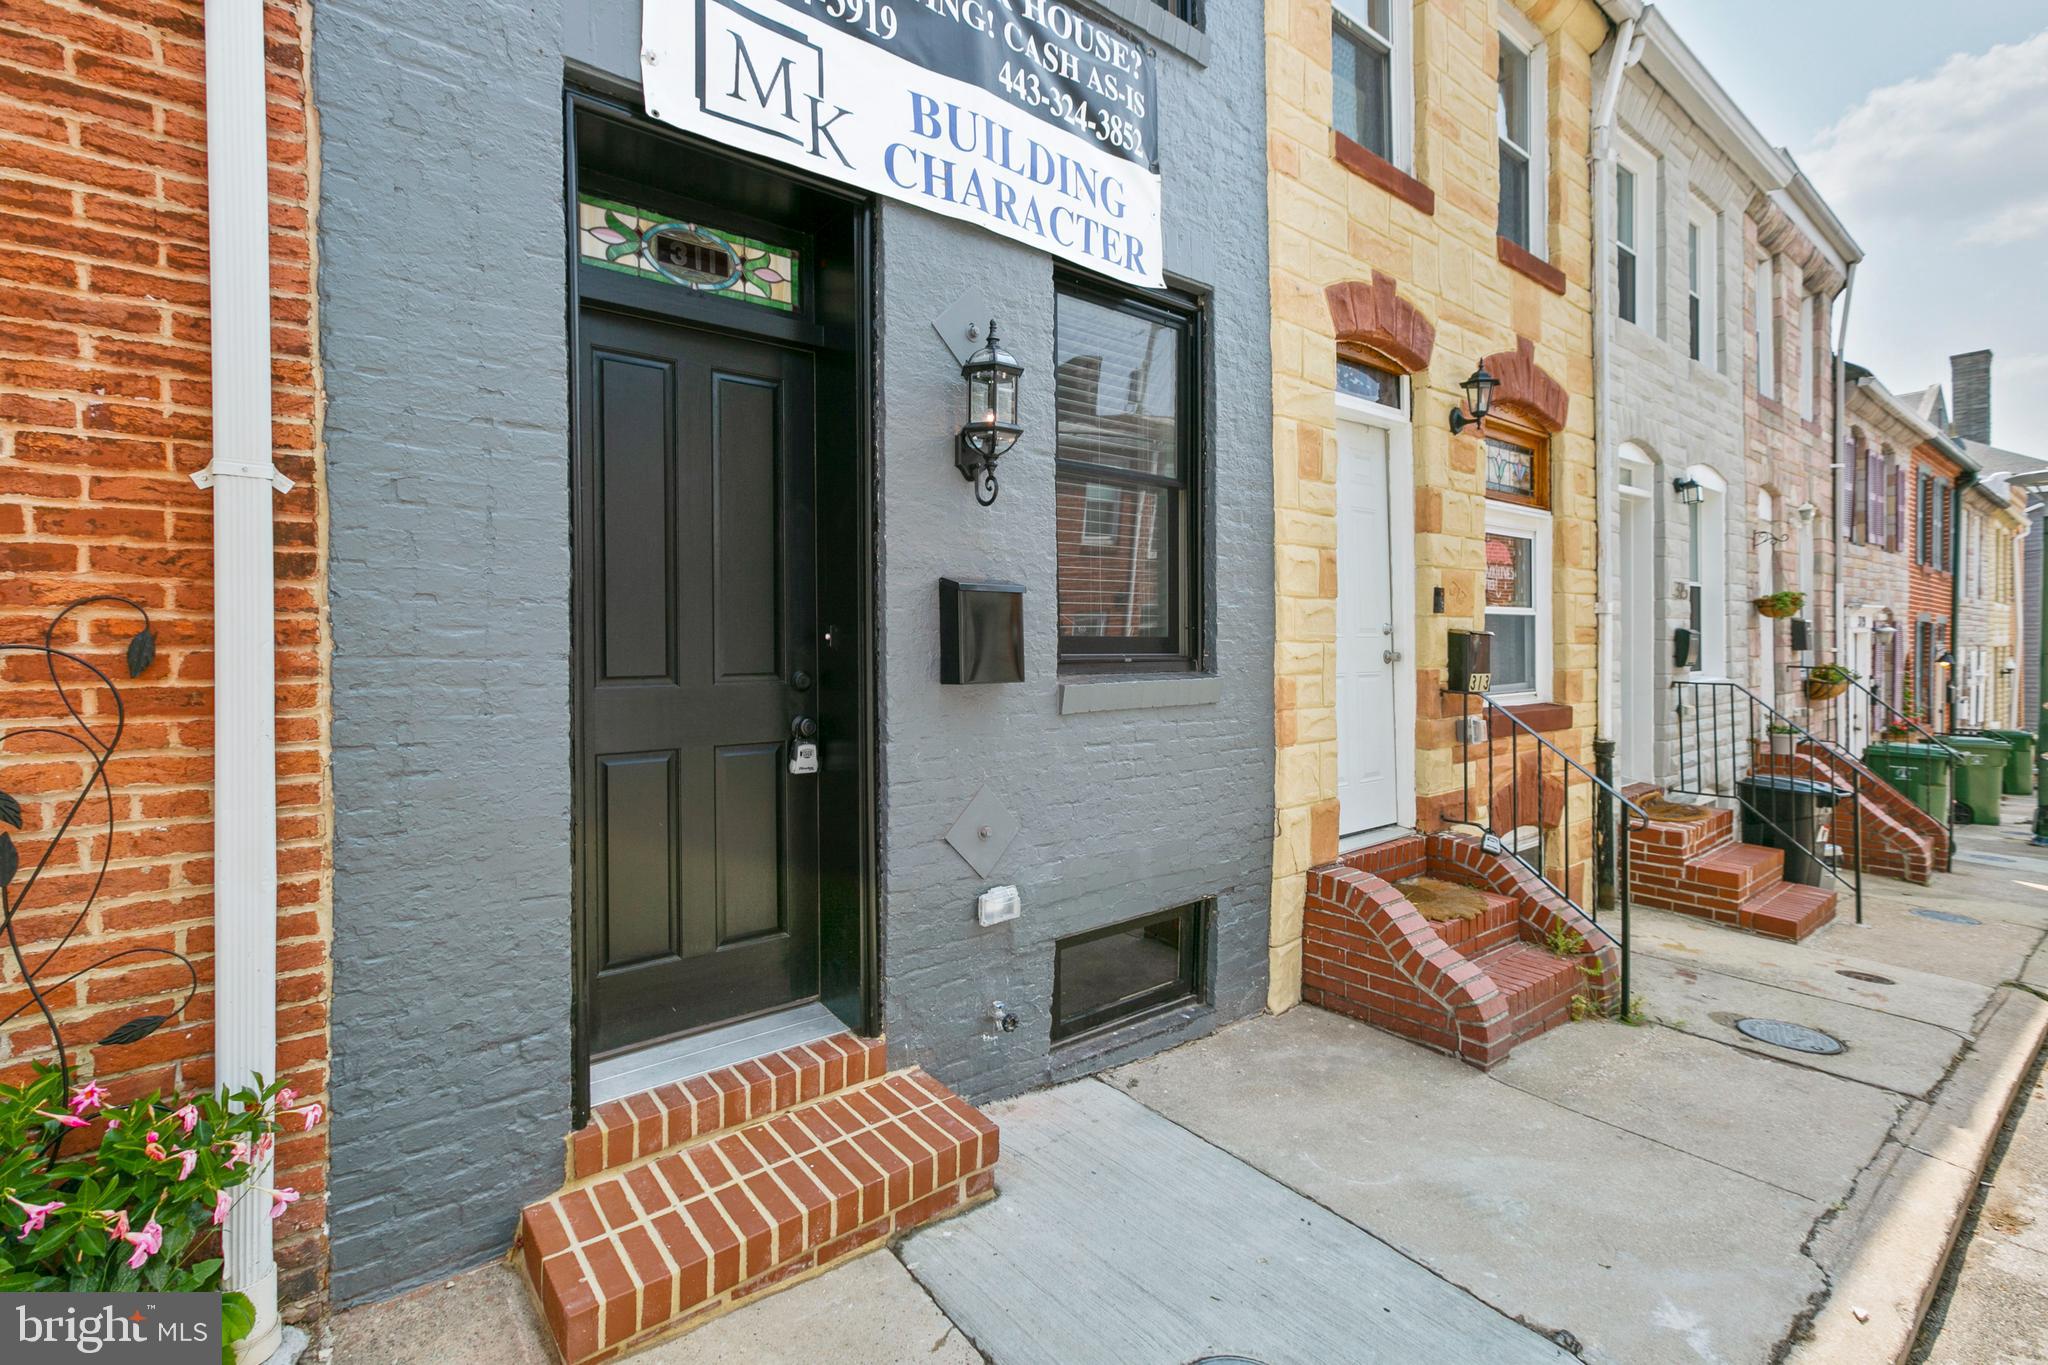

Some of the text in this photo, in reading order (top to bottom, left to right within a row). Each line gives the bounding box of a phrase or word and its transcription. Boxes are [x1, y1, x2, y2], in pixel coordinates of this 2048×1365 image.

[1003, 22, 1081, 83] CASH
[1087, 66, 1146, 119] AS-IS
[1021, 0, 1143, 80] HOUSE?
[907, 89, 1127, 219] BUILDING
[998, 60, 1144, 158] 443-324-3852
[884, 142, 1148, 276] CHARACTER
[669, 241, 717, 275] 311
[1470, 674, 1490, 690] 313
